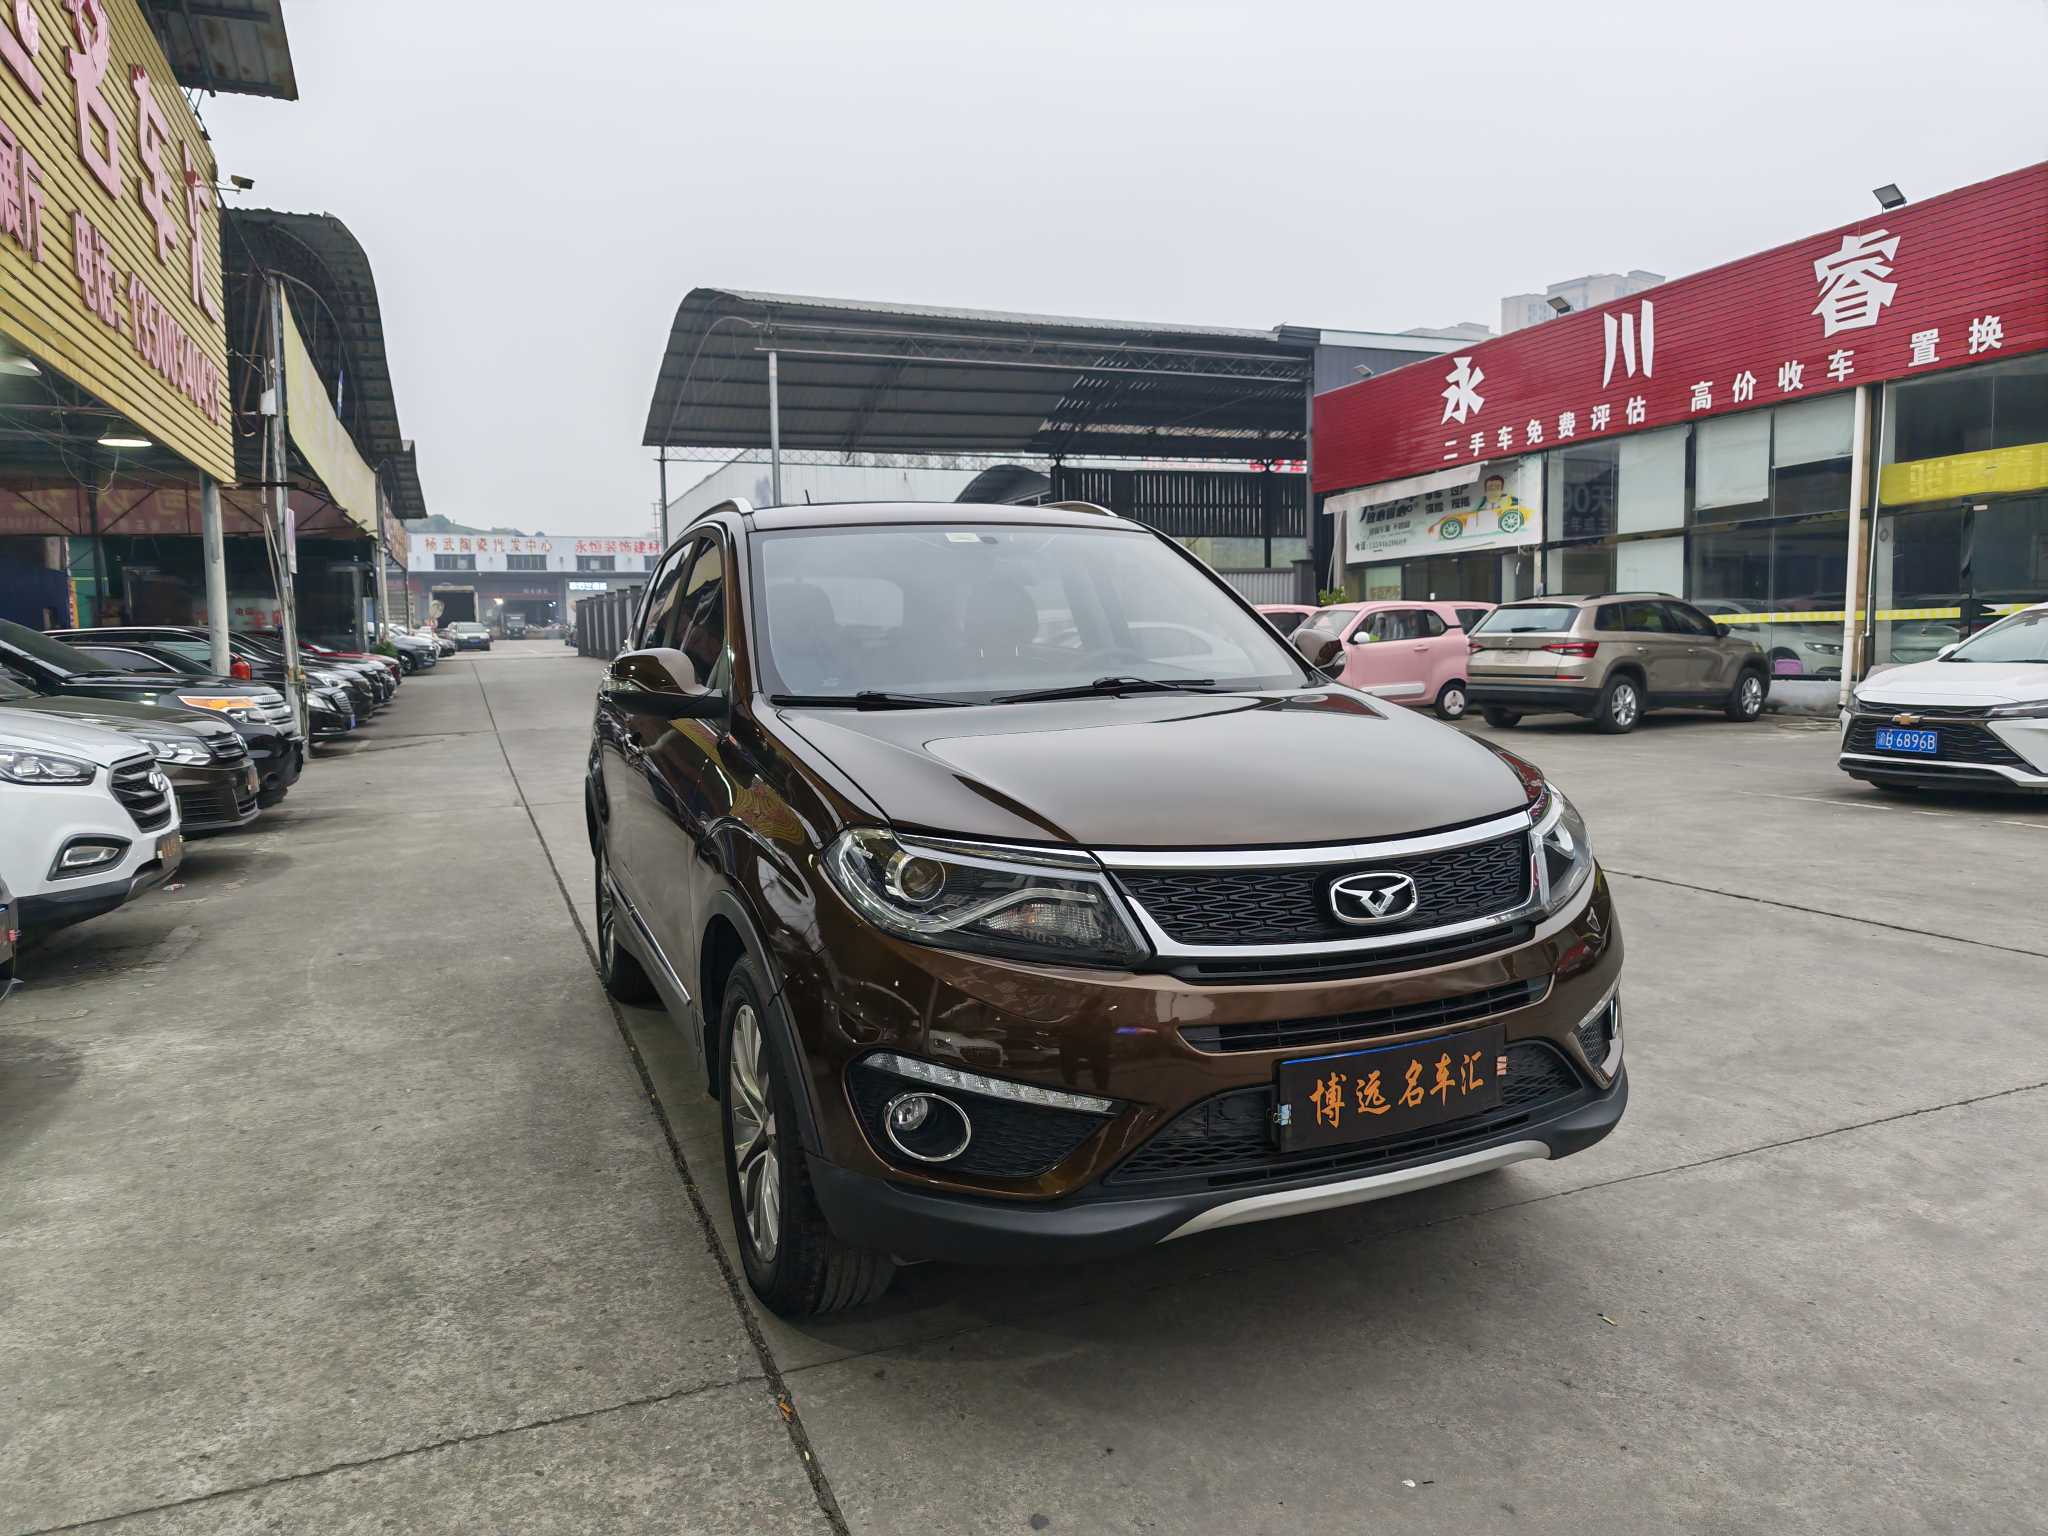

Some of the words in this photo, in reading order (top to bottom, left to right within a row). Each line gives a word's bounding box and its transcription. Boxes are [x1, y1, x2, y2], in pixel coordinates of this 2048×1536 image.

[1441, 229, 1901, 425] 永川睿
[1443, 396, 1646, 460] 二手车免费评估
[1690, 349, 1855, 412] 高价收车
[1908, 315, 2003, 367] 置换
[1309, 1051, 1484, 1128] 博远名车汇
